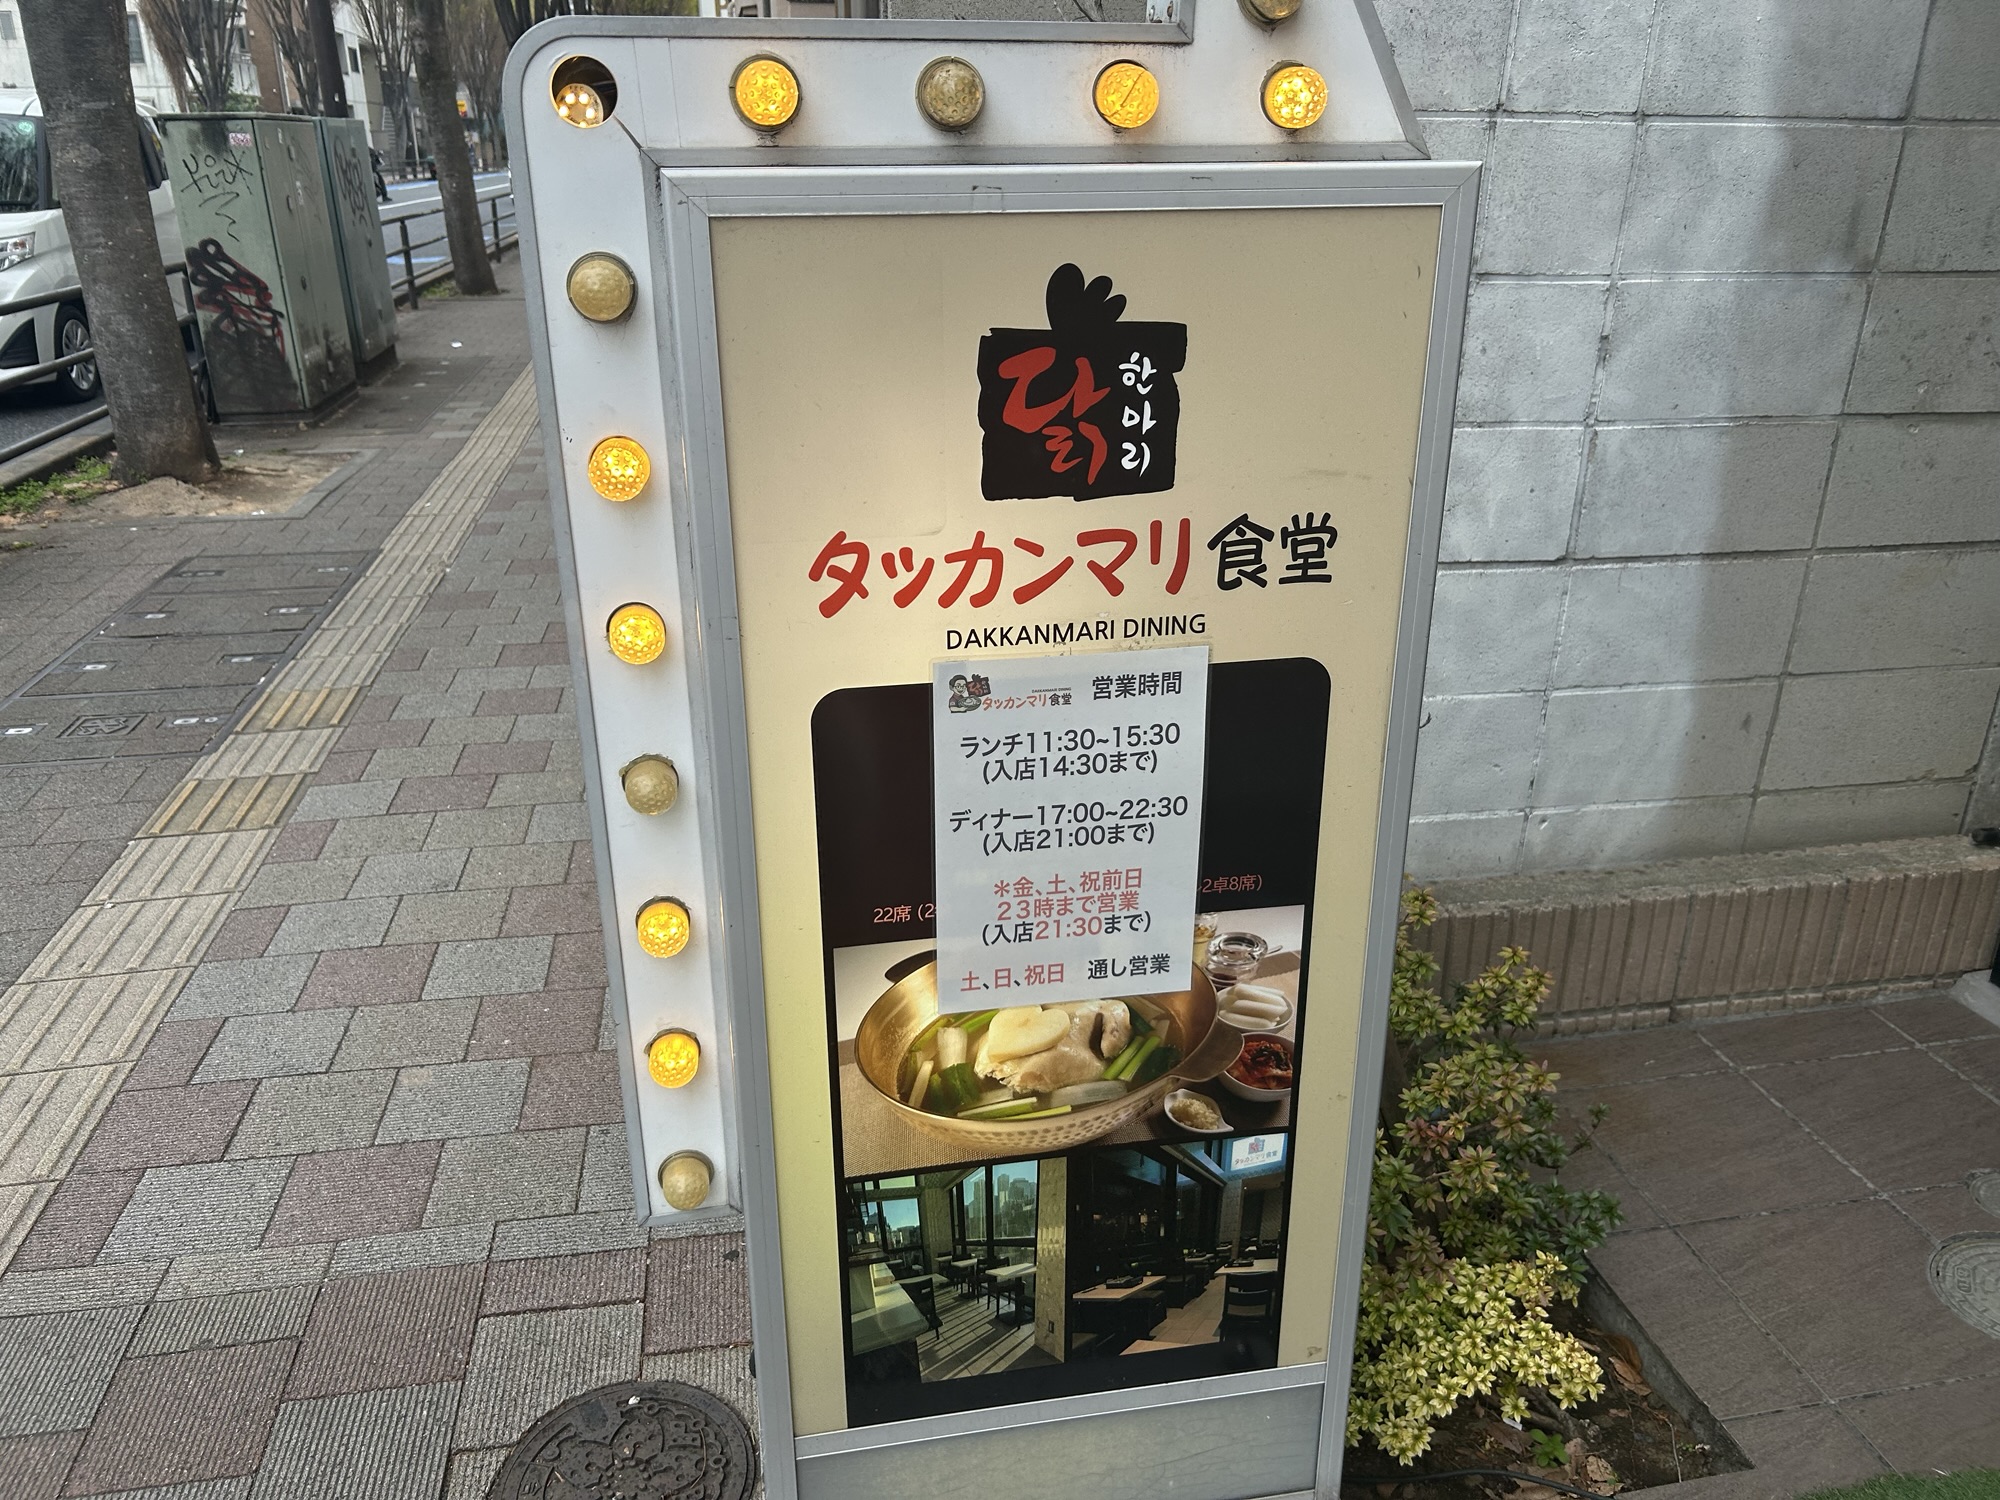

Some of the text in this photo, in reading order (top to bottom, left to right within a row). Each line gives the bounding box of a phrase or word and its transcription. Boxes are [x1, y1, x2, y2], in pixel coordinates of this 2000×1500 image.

[1119, 351, 1157, 477] 한마리
[808, 512, 1338, 618] タッカンマリ食堂
[946, 613, 1207, 650] DAKKANMARI DINING
[982, 692, 1072, 711] タッカンマリ食堂
[1092, 671, 1183, 701] 営業時間
[982, 750, 1158, 785] (入店14:30まで)
[982, 822, 1156, 856] (入店21:00まで)
[1197, 874, 1263, 893] 2卓8席)
[997, 890, 1140, 921] 23時まで営業
[982, 911, 1152, 946] (入店21:30まで)
[960, 953, 1171, 992] 土、日、祝日 通し営業
